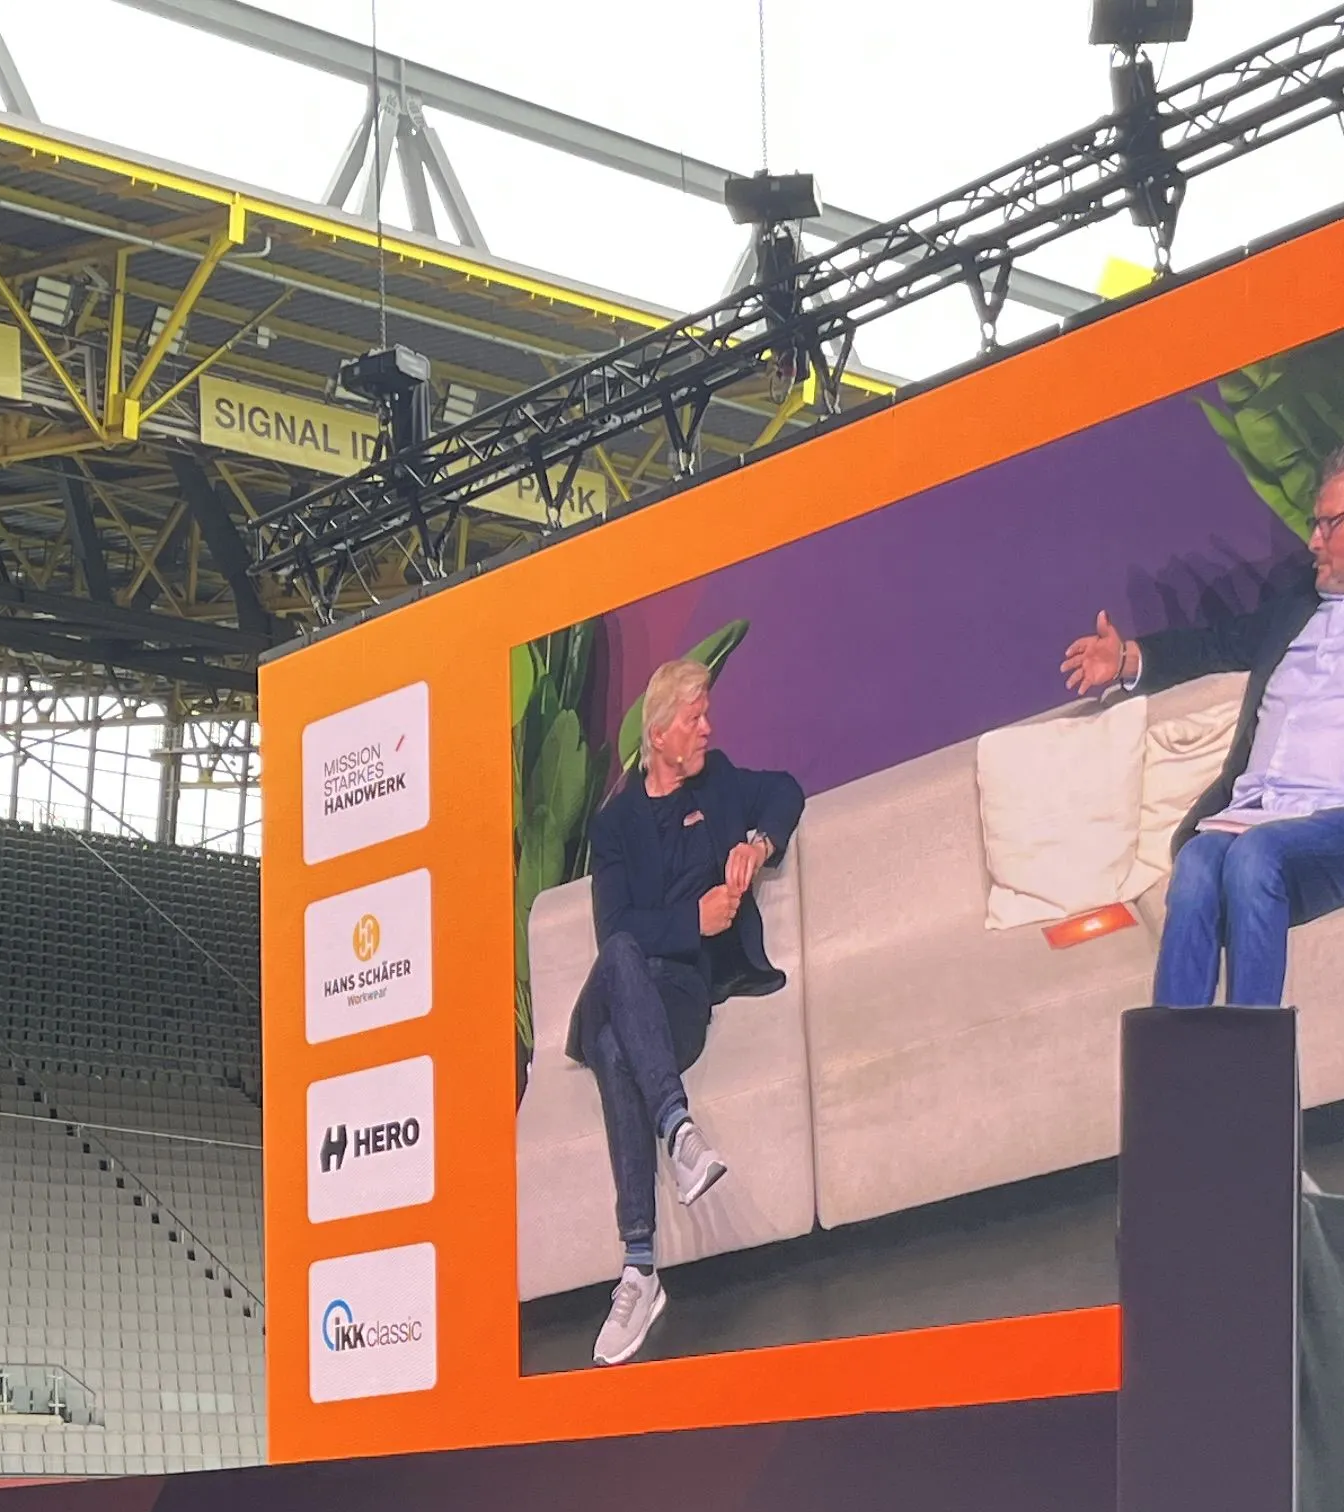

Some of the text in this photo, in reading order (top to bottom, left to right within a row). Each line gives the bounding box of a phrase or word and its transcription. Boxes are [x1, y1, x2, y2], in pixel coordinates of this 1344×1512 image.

[215, 398, 340, 455] SIGNAL
[324, 743, 381, 777] MISSION
[324, 762, 384, 797] STARKES
[324, 772, 406, 816] HANDWERK
[324, 959, 412, 997] HANS SCHÄFER
[354, 1117, 420, 1158] HERO
